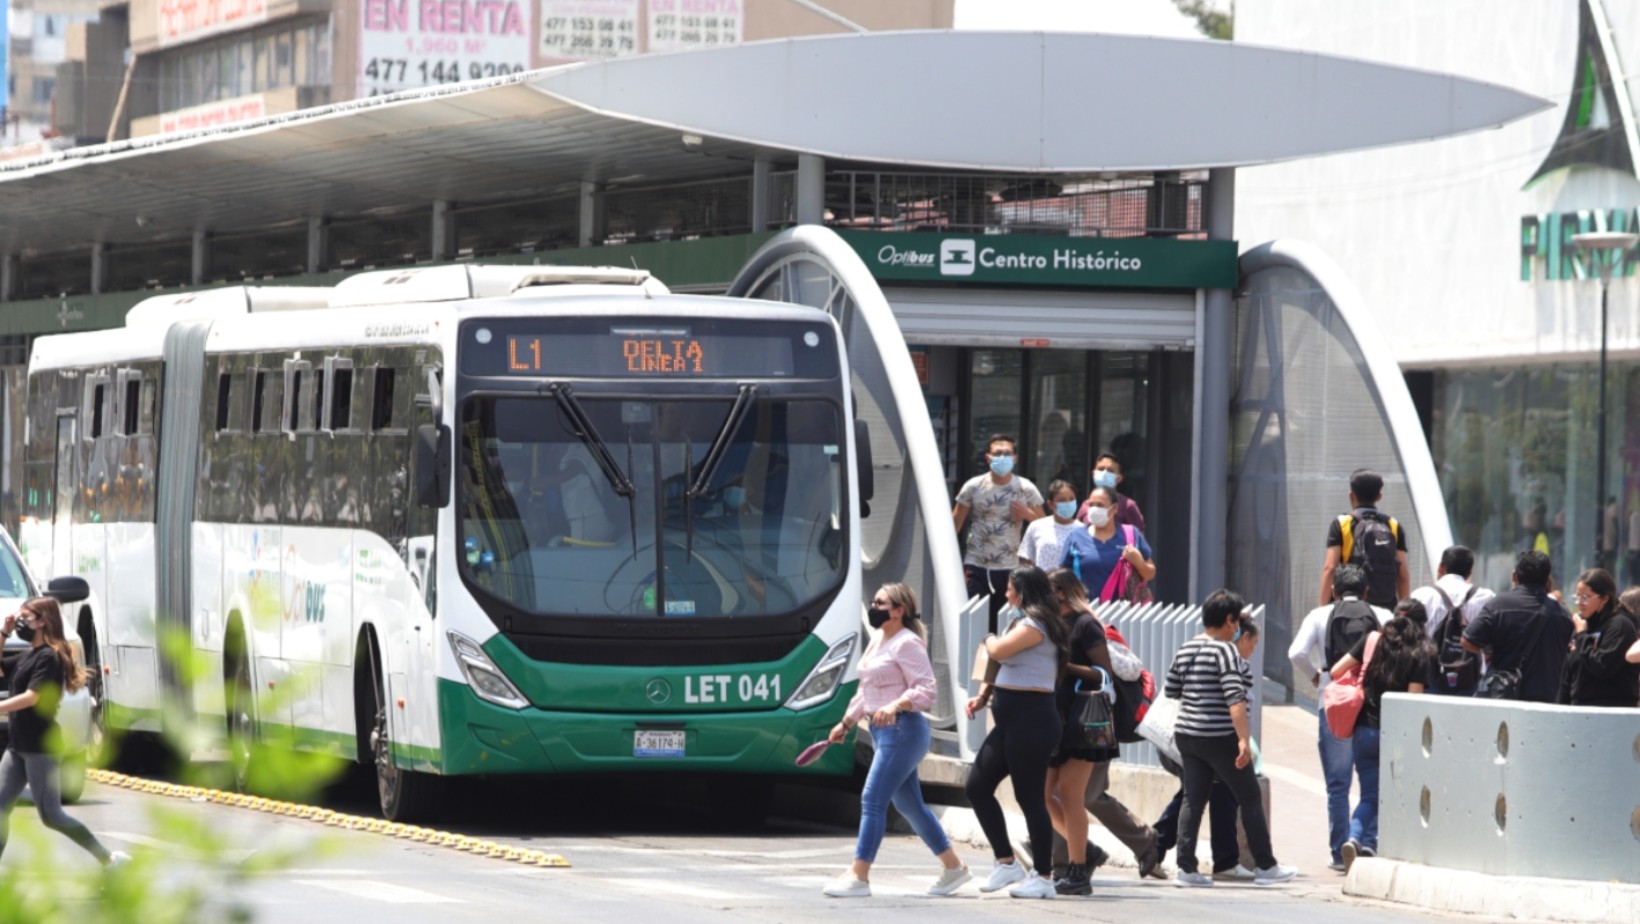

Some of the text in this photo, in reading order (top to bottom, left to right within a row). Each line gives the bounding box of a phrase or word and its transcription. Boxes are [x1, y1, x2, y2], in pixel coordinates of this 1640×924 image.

[364, 0, 526, 36] EN RENTA
[365, 56, 407, 82] 477
[418, 58, 461, 84] 144
[979, 247, 1047, 269] Centro
[1053, 249, 1142, 271] Histórico
[510, 338, 541, 371] L1
[623, 339, 703, 358] DELTA
[684, 673, 781, 703] LET 041
